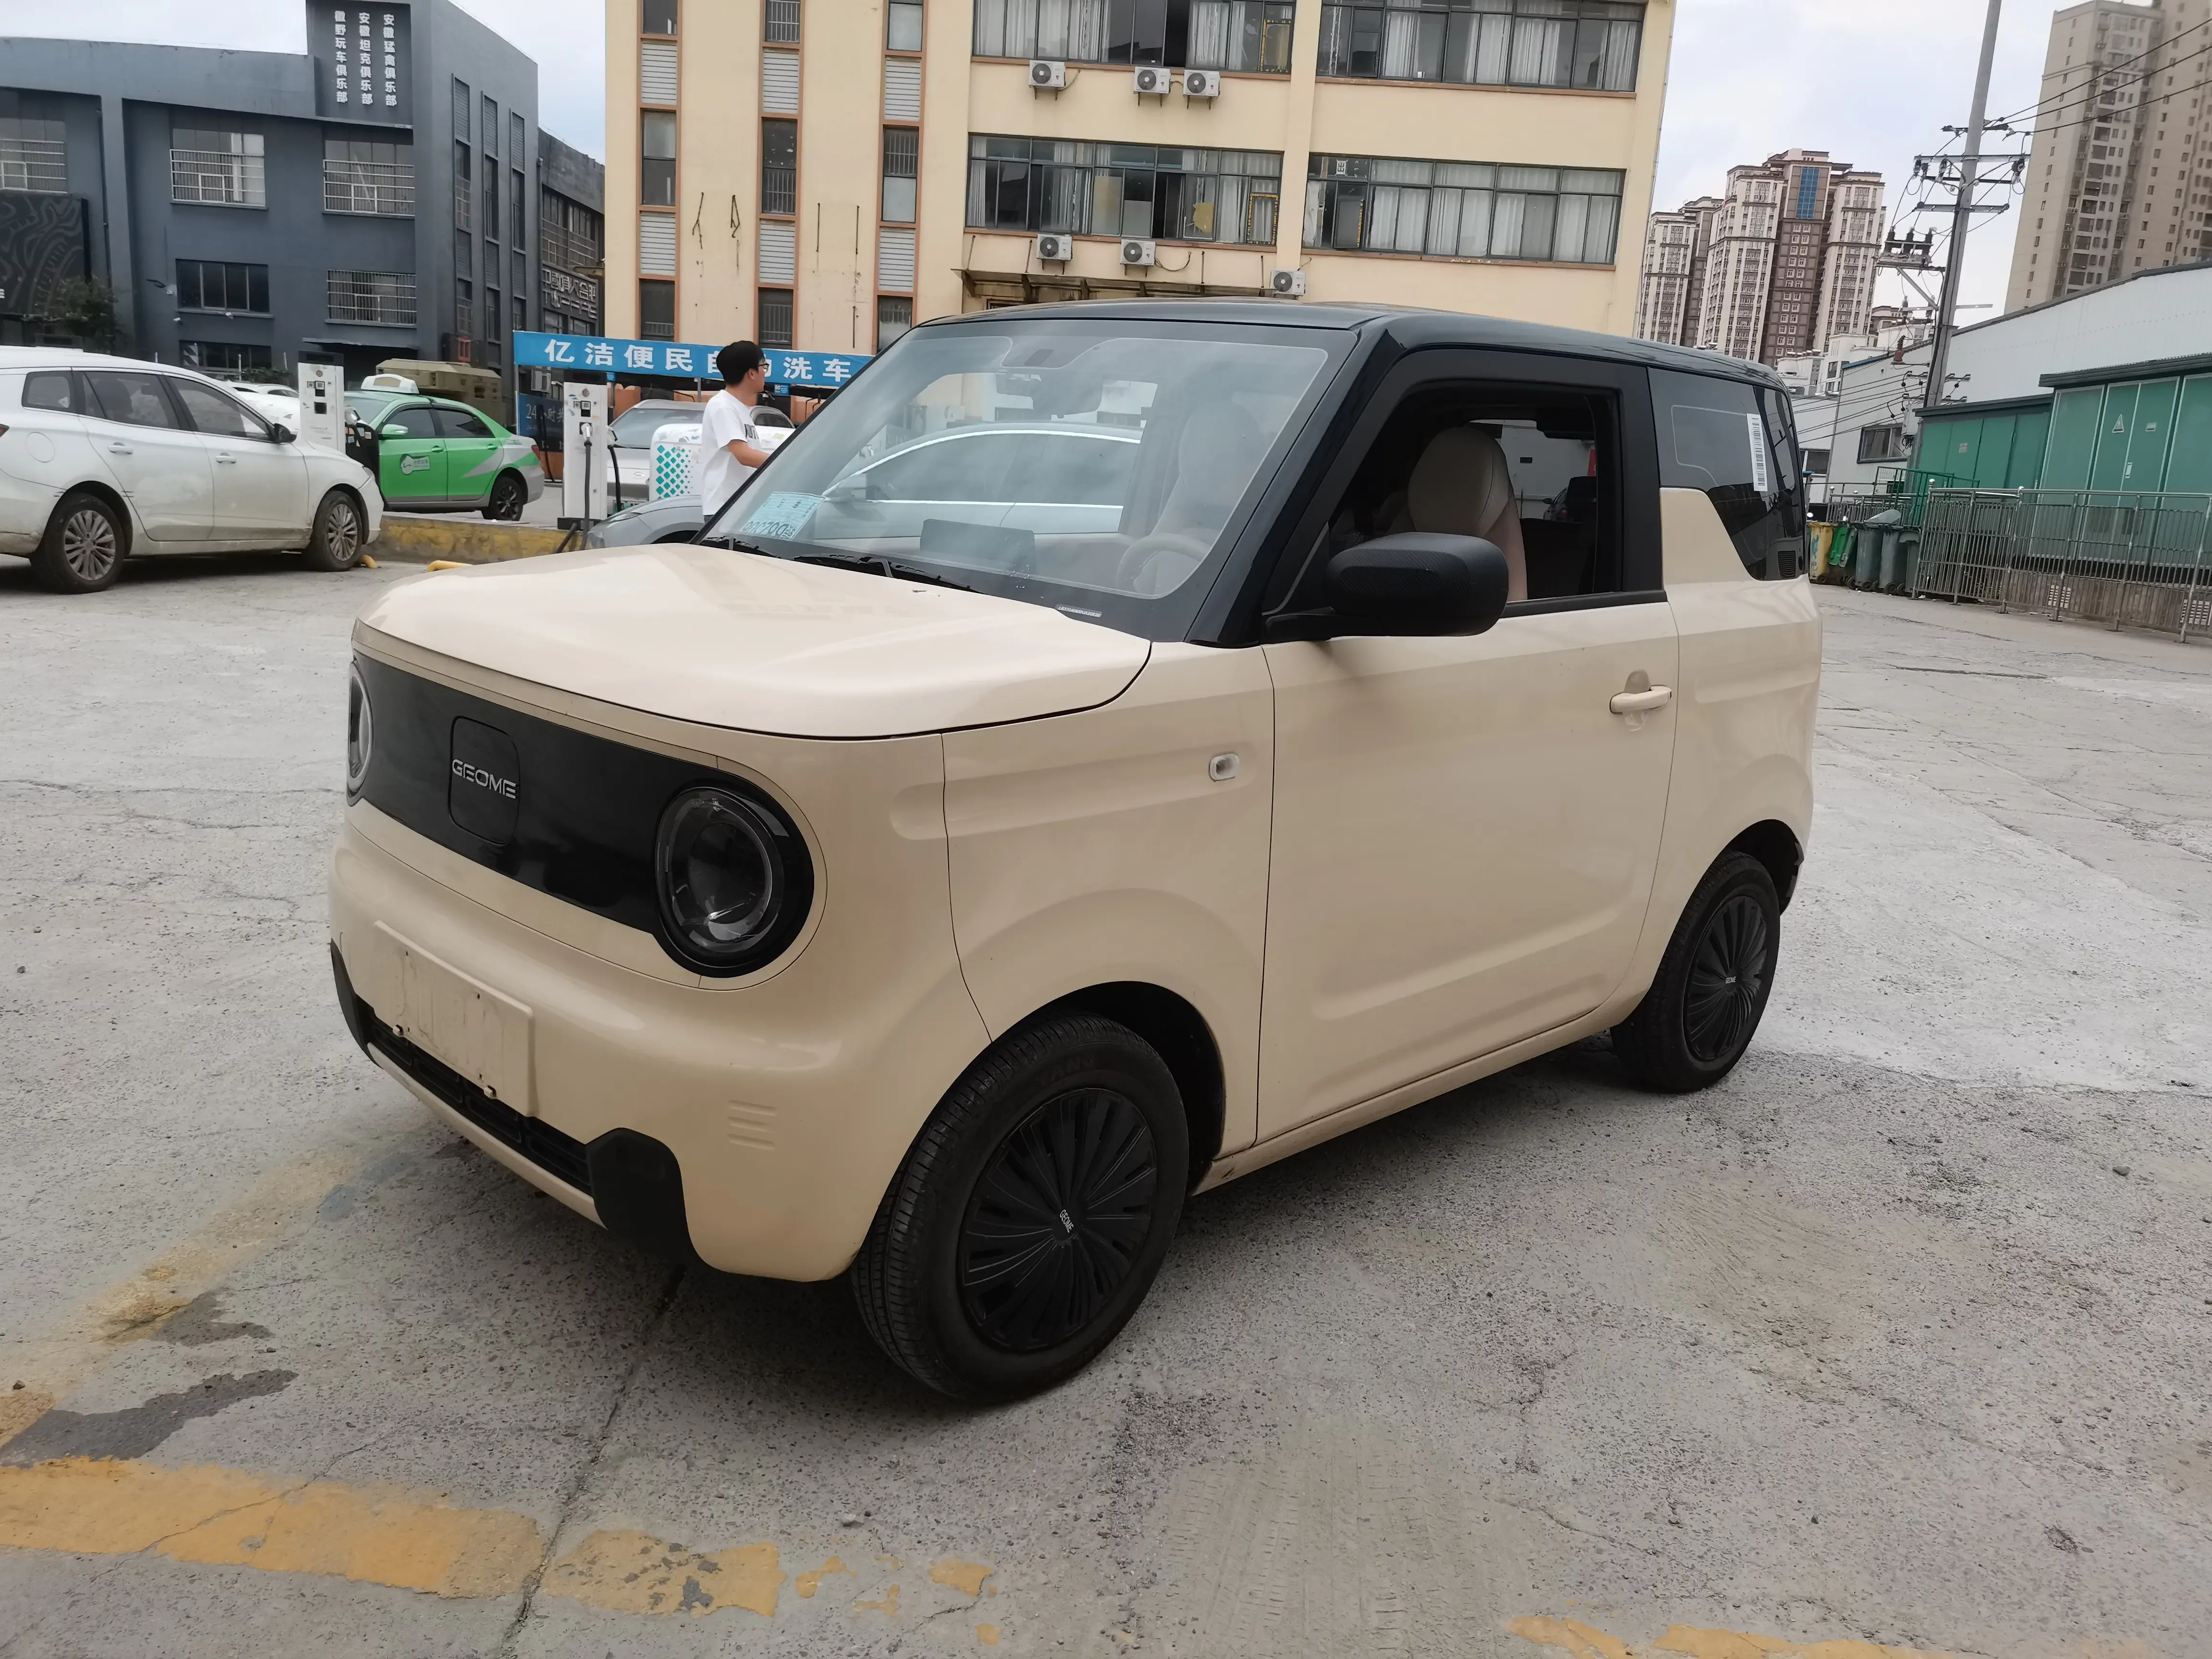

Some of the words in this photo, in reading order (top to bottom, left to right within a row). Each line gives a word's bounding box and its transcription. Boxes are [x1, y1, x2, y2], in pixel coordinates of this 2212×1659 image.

[544, 339, 852, 382] 亿洁便民洗车
[452, 758, 517, 799] GEOME
[1059, 1209, 1074, 1233] GEOME
